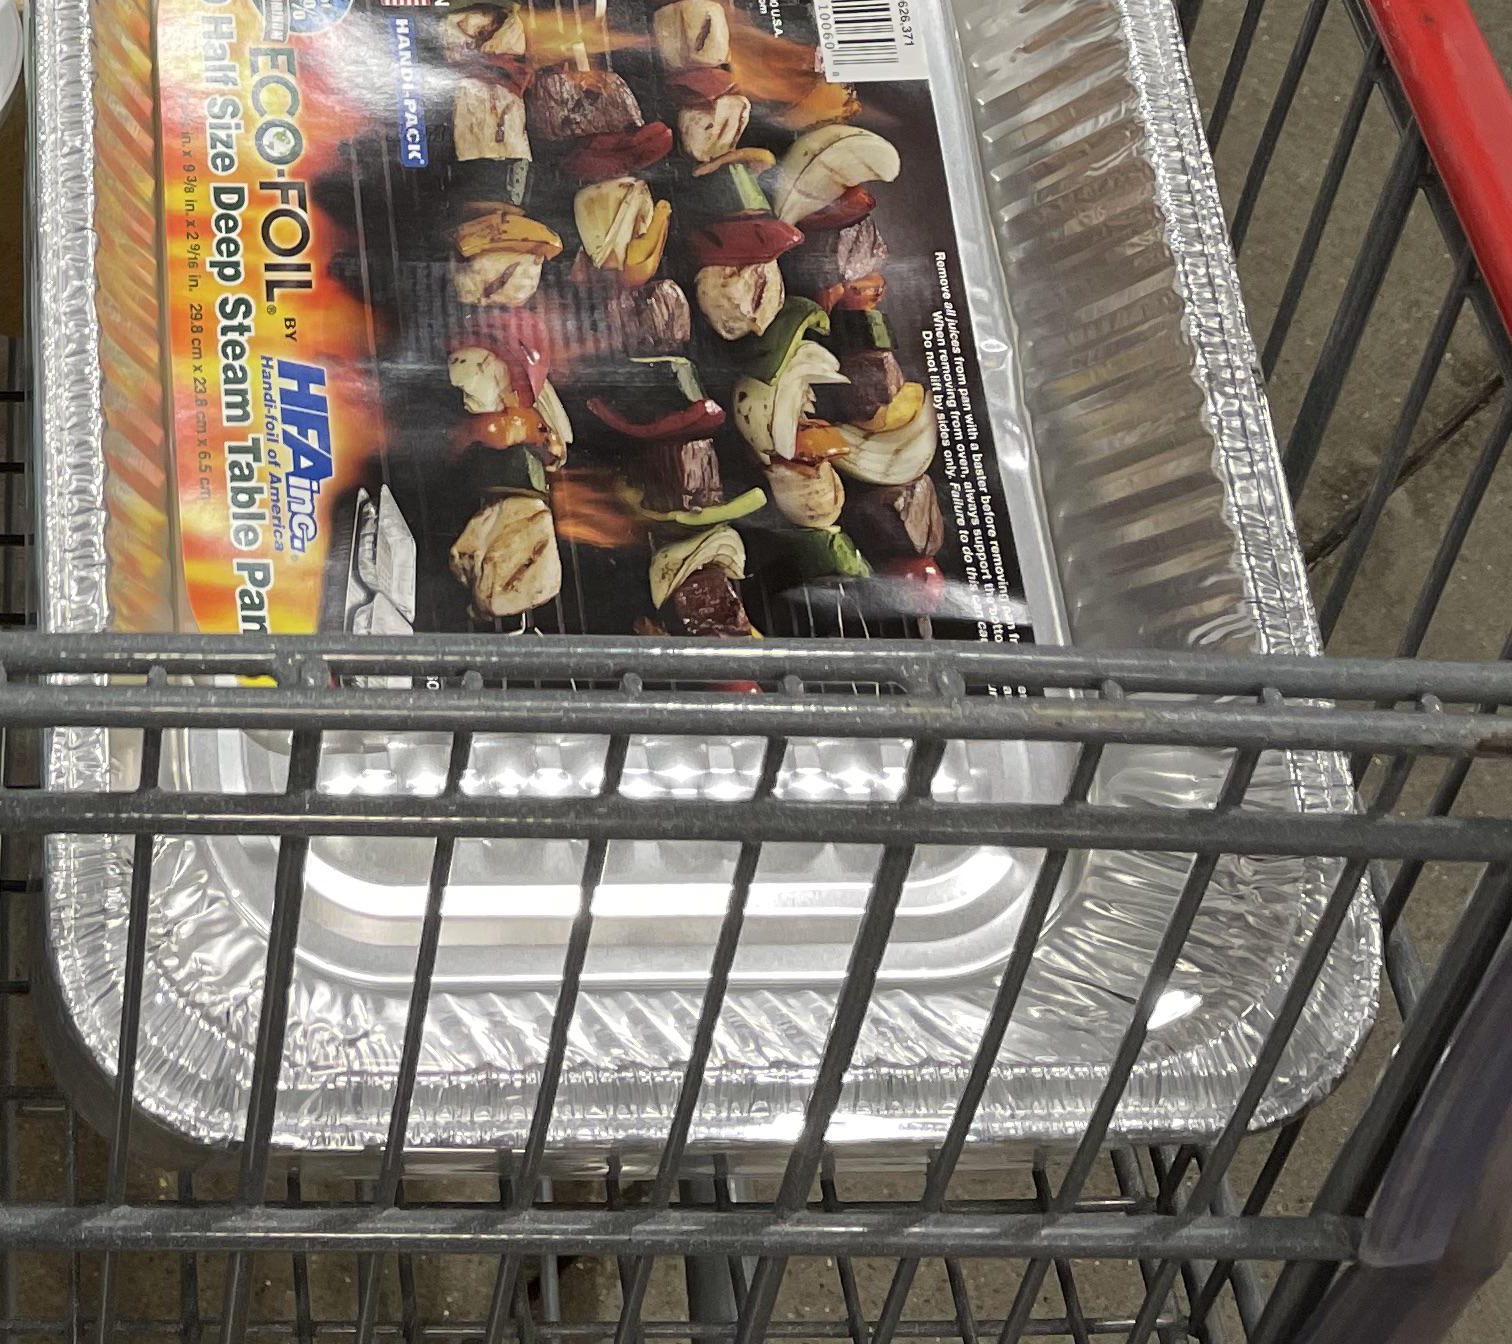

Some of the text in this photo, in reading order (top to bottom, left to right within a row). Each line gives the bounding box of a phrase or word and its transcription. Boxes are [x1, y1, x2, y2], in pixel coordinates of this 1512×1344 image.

[198, 12, 240, 89] Half
[818, 4, 836, 50] 10060
[204, 94, 245, 177] Size
[392, 16, 425, 161] HANDI-PACK
[206, 182, 249, 286] Deep
[248, 47, 314, 343] ECO-FOIL BY
[189, 302, 203, 334] 29.8
[215, 293, 257, 427] Steam
[260, 354, 285, 553] Handi-foil America
[931, 310, 992, 580] When removing from always support
[934, 250, 1010, 602] Remove juices from baster before removing
[937, 412, 966, 527] sides Failure
[224, 435, 269, 554] Table
